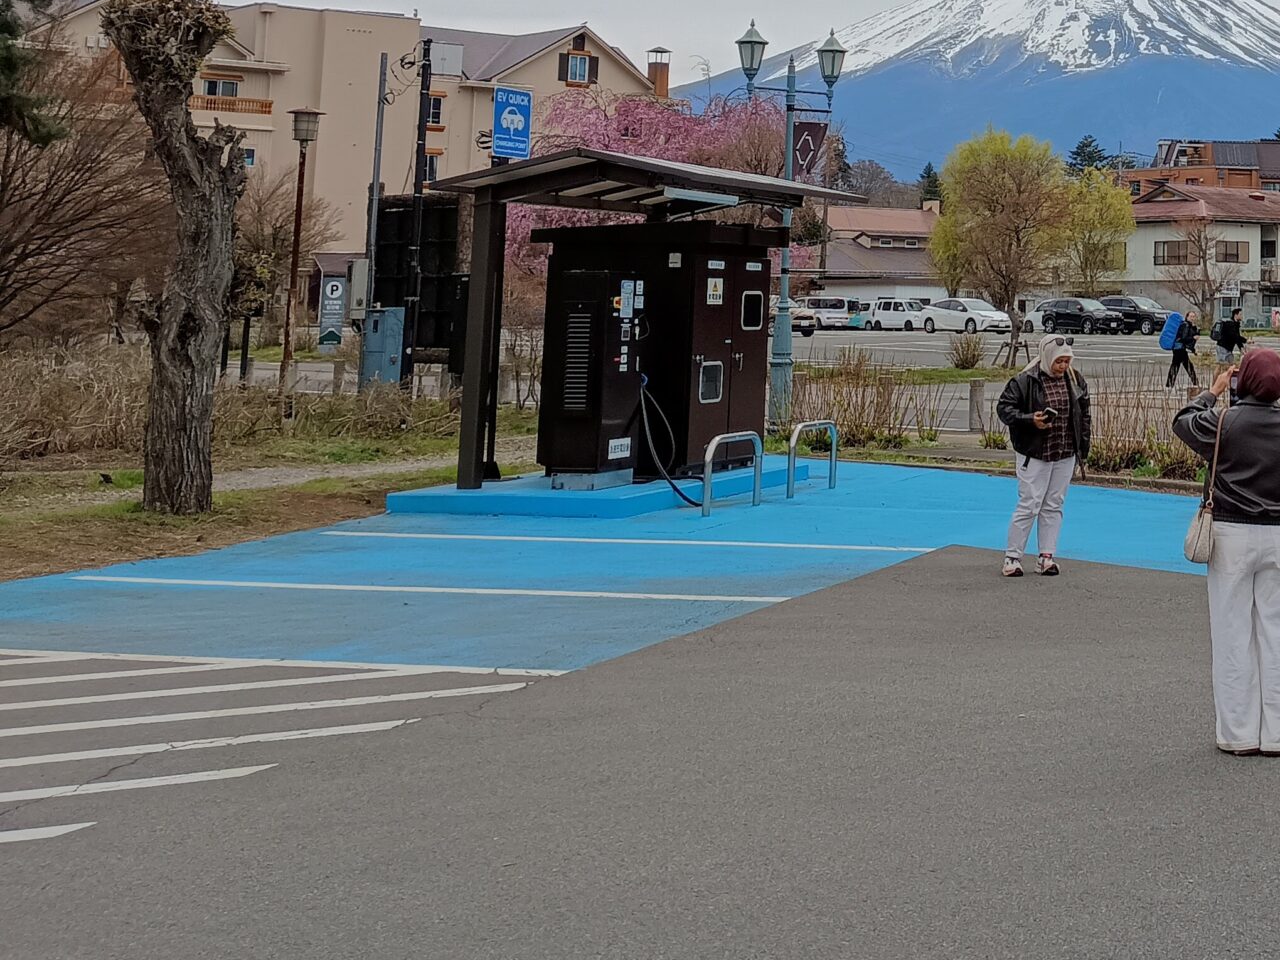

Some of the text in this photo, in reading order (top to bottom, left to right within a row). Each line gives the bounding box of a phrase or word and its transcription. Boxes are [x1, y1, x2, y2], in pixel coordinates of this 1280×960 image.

[497, 92, 529, 106] EV QUICK
[330, 284, 339, 296] P
